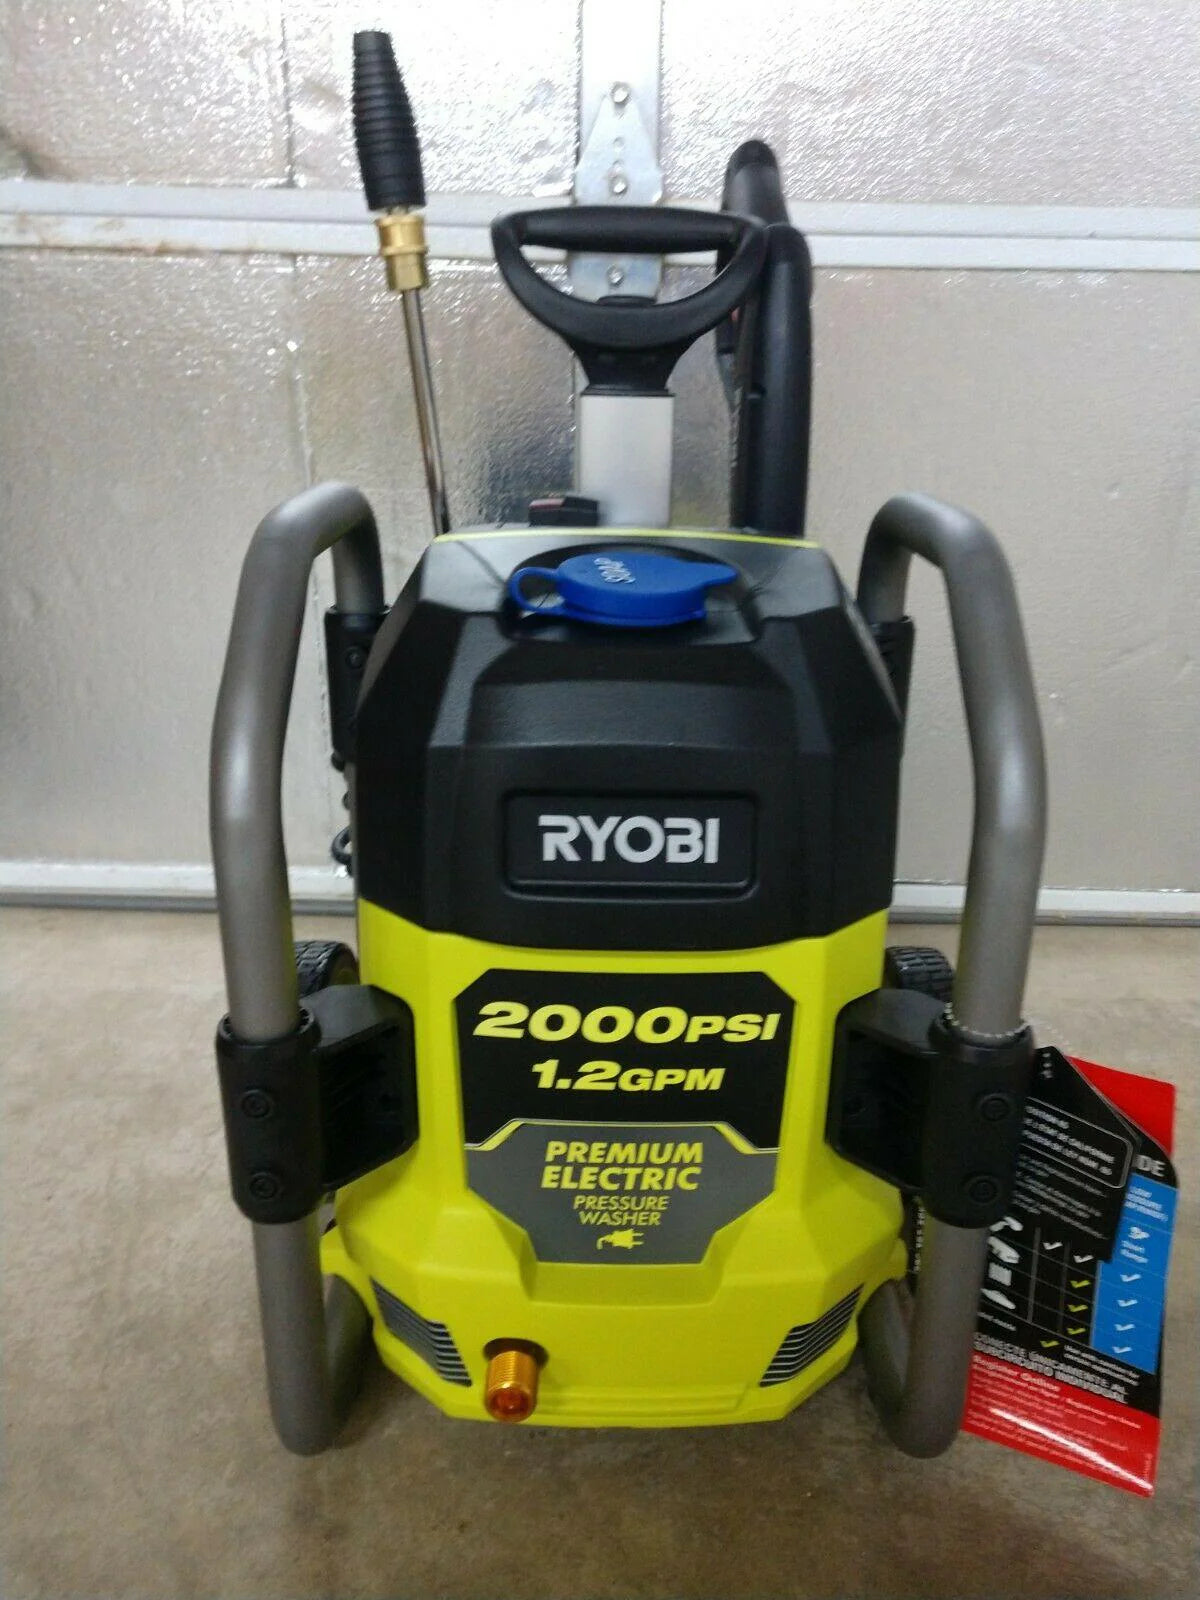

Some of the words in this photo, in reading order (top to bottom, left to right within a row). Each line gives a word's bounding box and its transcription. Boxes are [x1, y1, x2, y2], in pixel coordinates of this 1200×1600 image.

[539, 815, 719, 863] RYOBI
[473, 1002, 780, 1043] 2000PSI
[533, 1059, 725, 1091] 1.2GPM
[546, 1141, 703, 1164] PREMIUM
[541, 1166, 701, 1190] ELECTRIC
[574, 1195, 669, 1210] PRESSURE
[579, 1209, 664, 1225] WASHER
